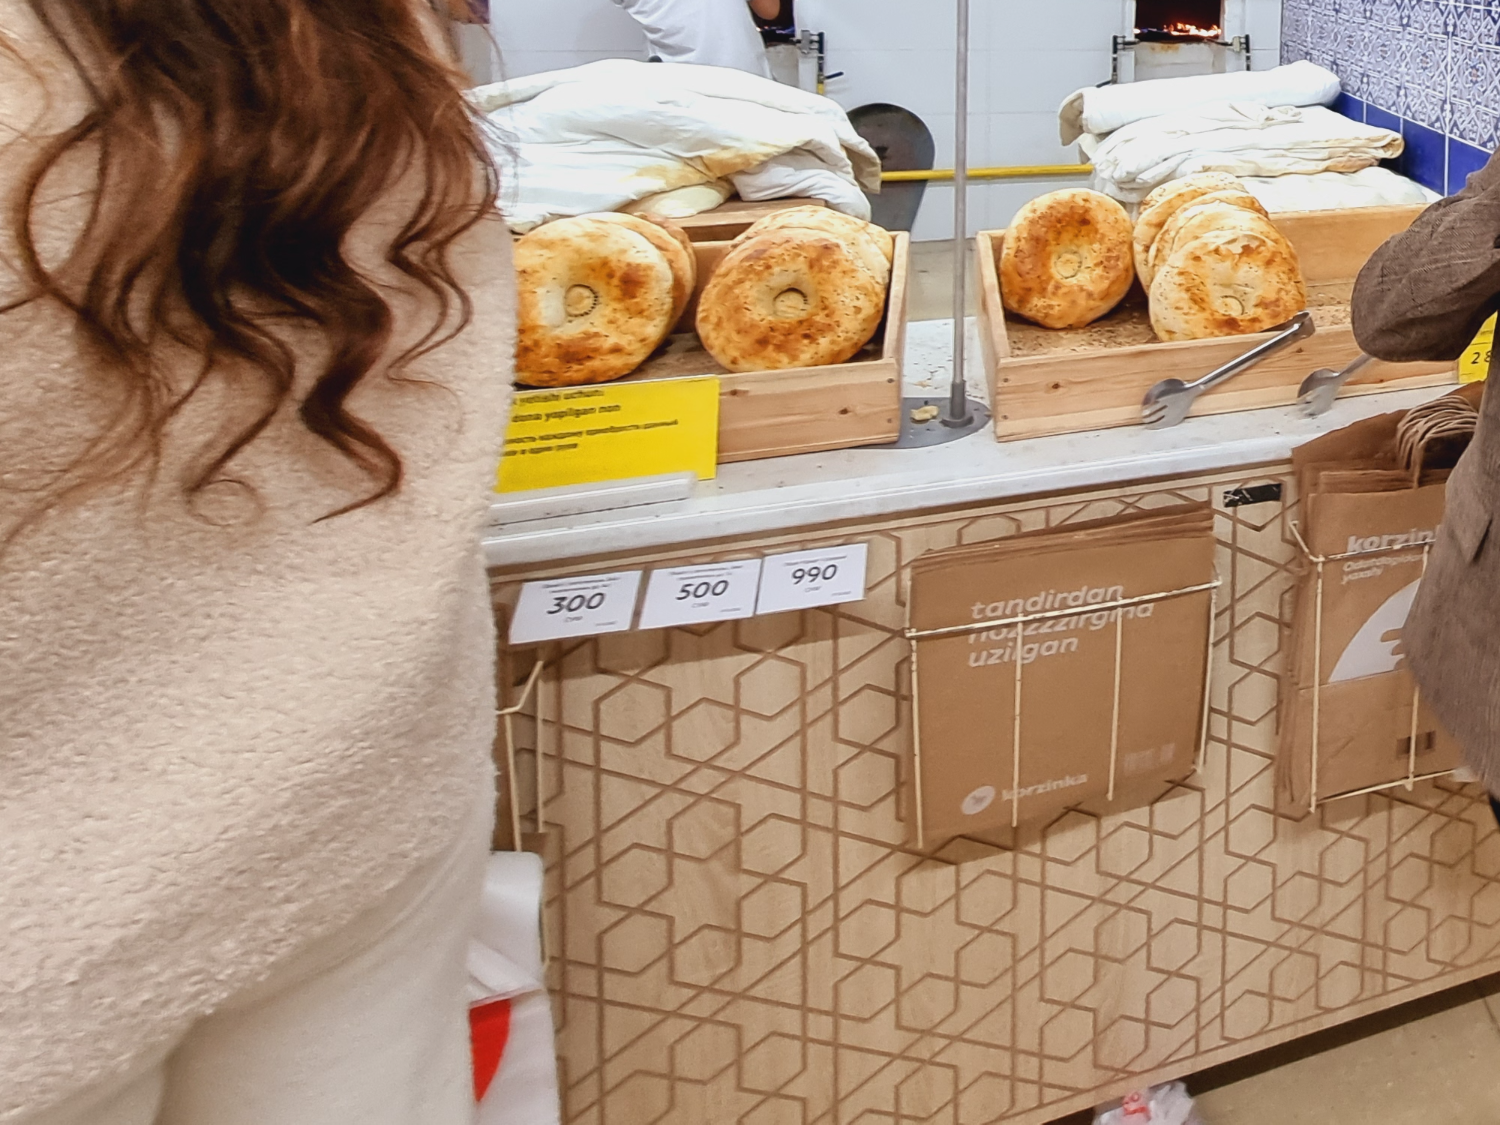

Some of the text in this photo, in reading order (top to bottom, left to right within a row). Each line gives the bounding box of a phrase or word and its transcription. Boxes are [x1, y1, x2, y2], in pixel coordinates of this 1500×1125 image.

[792, 564, 838, 585] 990
[676, 579, 729, 601] 500
[546, 592, 606, 615] 300
[971, 584, 1124, 619] tandirdan
